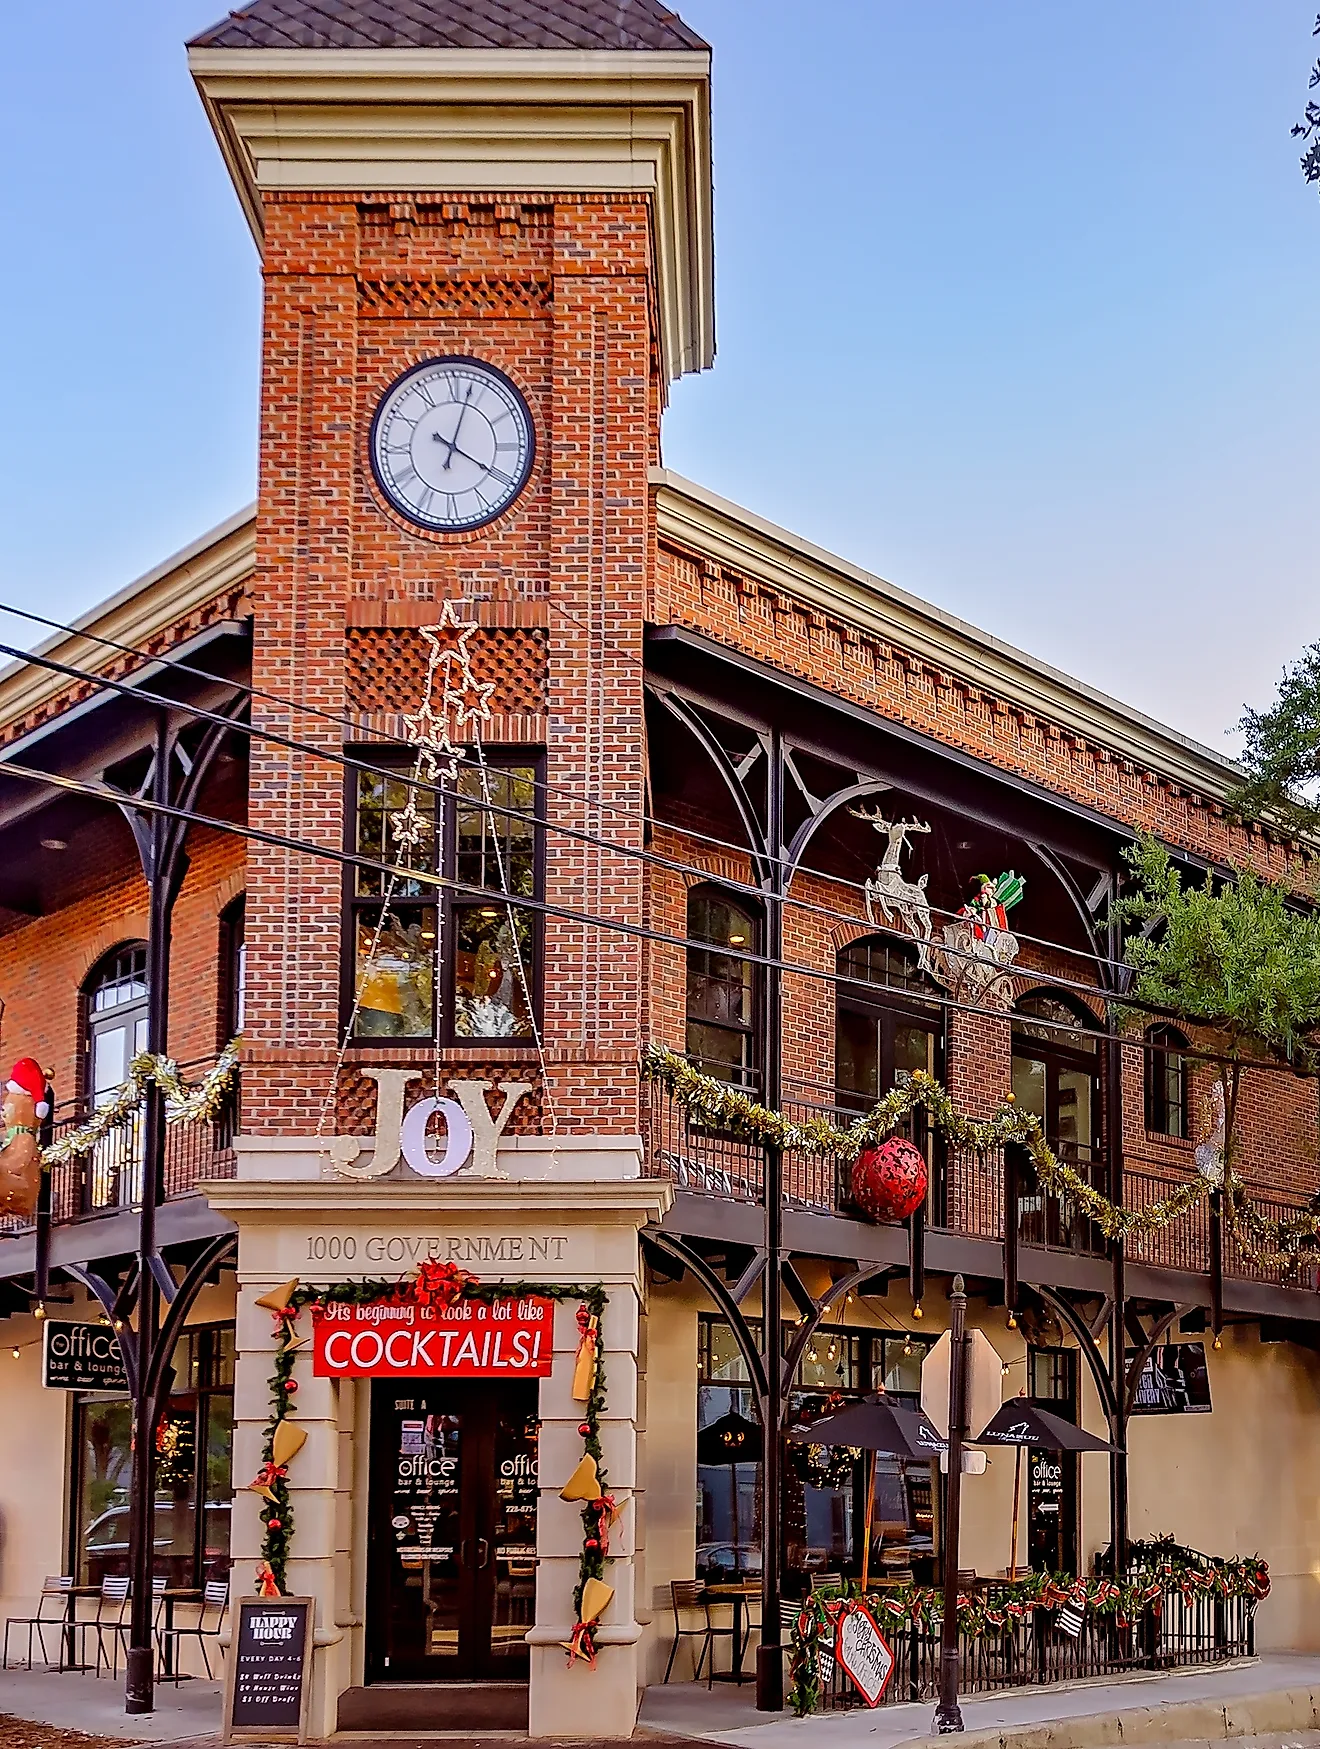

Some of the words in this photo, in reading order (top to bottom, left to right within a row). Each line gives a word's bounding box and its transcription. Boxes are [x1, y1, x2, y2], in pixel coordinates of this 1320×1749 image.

[330, 1067, 533, 1180] JOY
[306, 1236, 357, 1260] 1000
[365, 1236, 569, 1261] GOVERNMENT
[356, 1302, 415, 1326] beginning
[477, 1305, 487, 1321] a
[492, 1299, 513, 1321] lot
[517, 1299, 544, 1321] like
[51, 1326, 121, 1360] office
[324, 1330, 542, 1369] COCKTAILS!
[49, 1359, 70, 1370] bar
[74, 1360, 83, 1371] &
[88, 1361, 127, 1376] lounge
[394, 1399, 415, 1411] SUITE
[420, 1399, 427, 1410] A
[398, 1454, 456, 1477] office
[1033, 1460, 1062, 1480] office
[397, 1478, 413, 1486] bar
[249, 1616, 298, 1629] HAPPY
[252, 1628, 293, 1640] HOUR
[255, 1695, 271, 1704] Off
[272, 1695, 296, 1704] Draft
